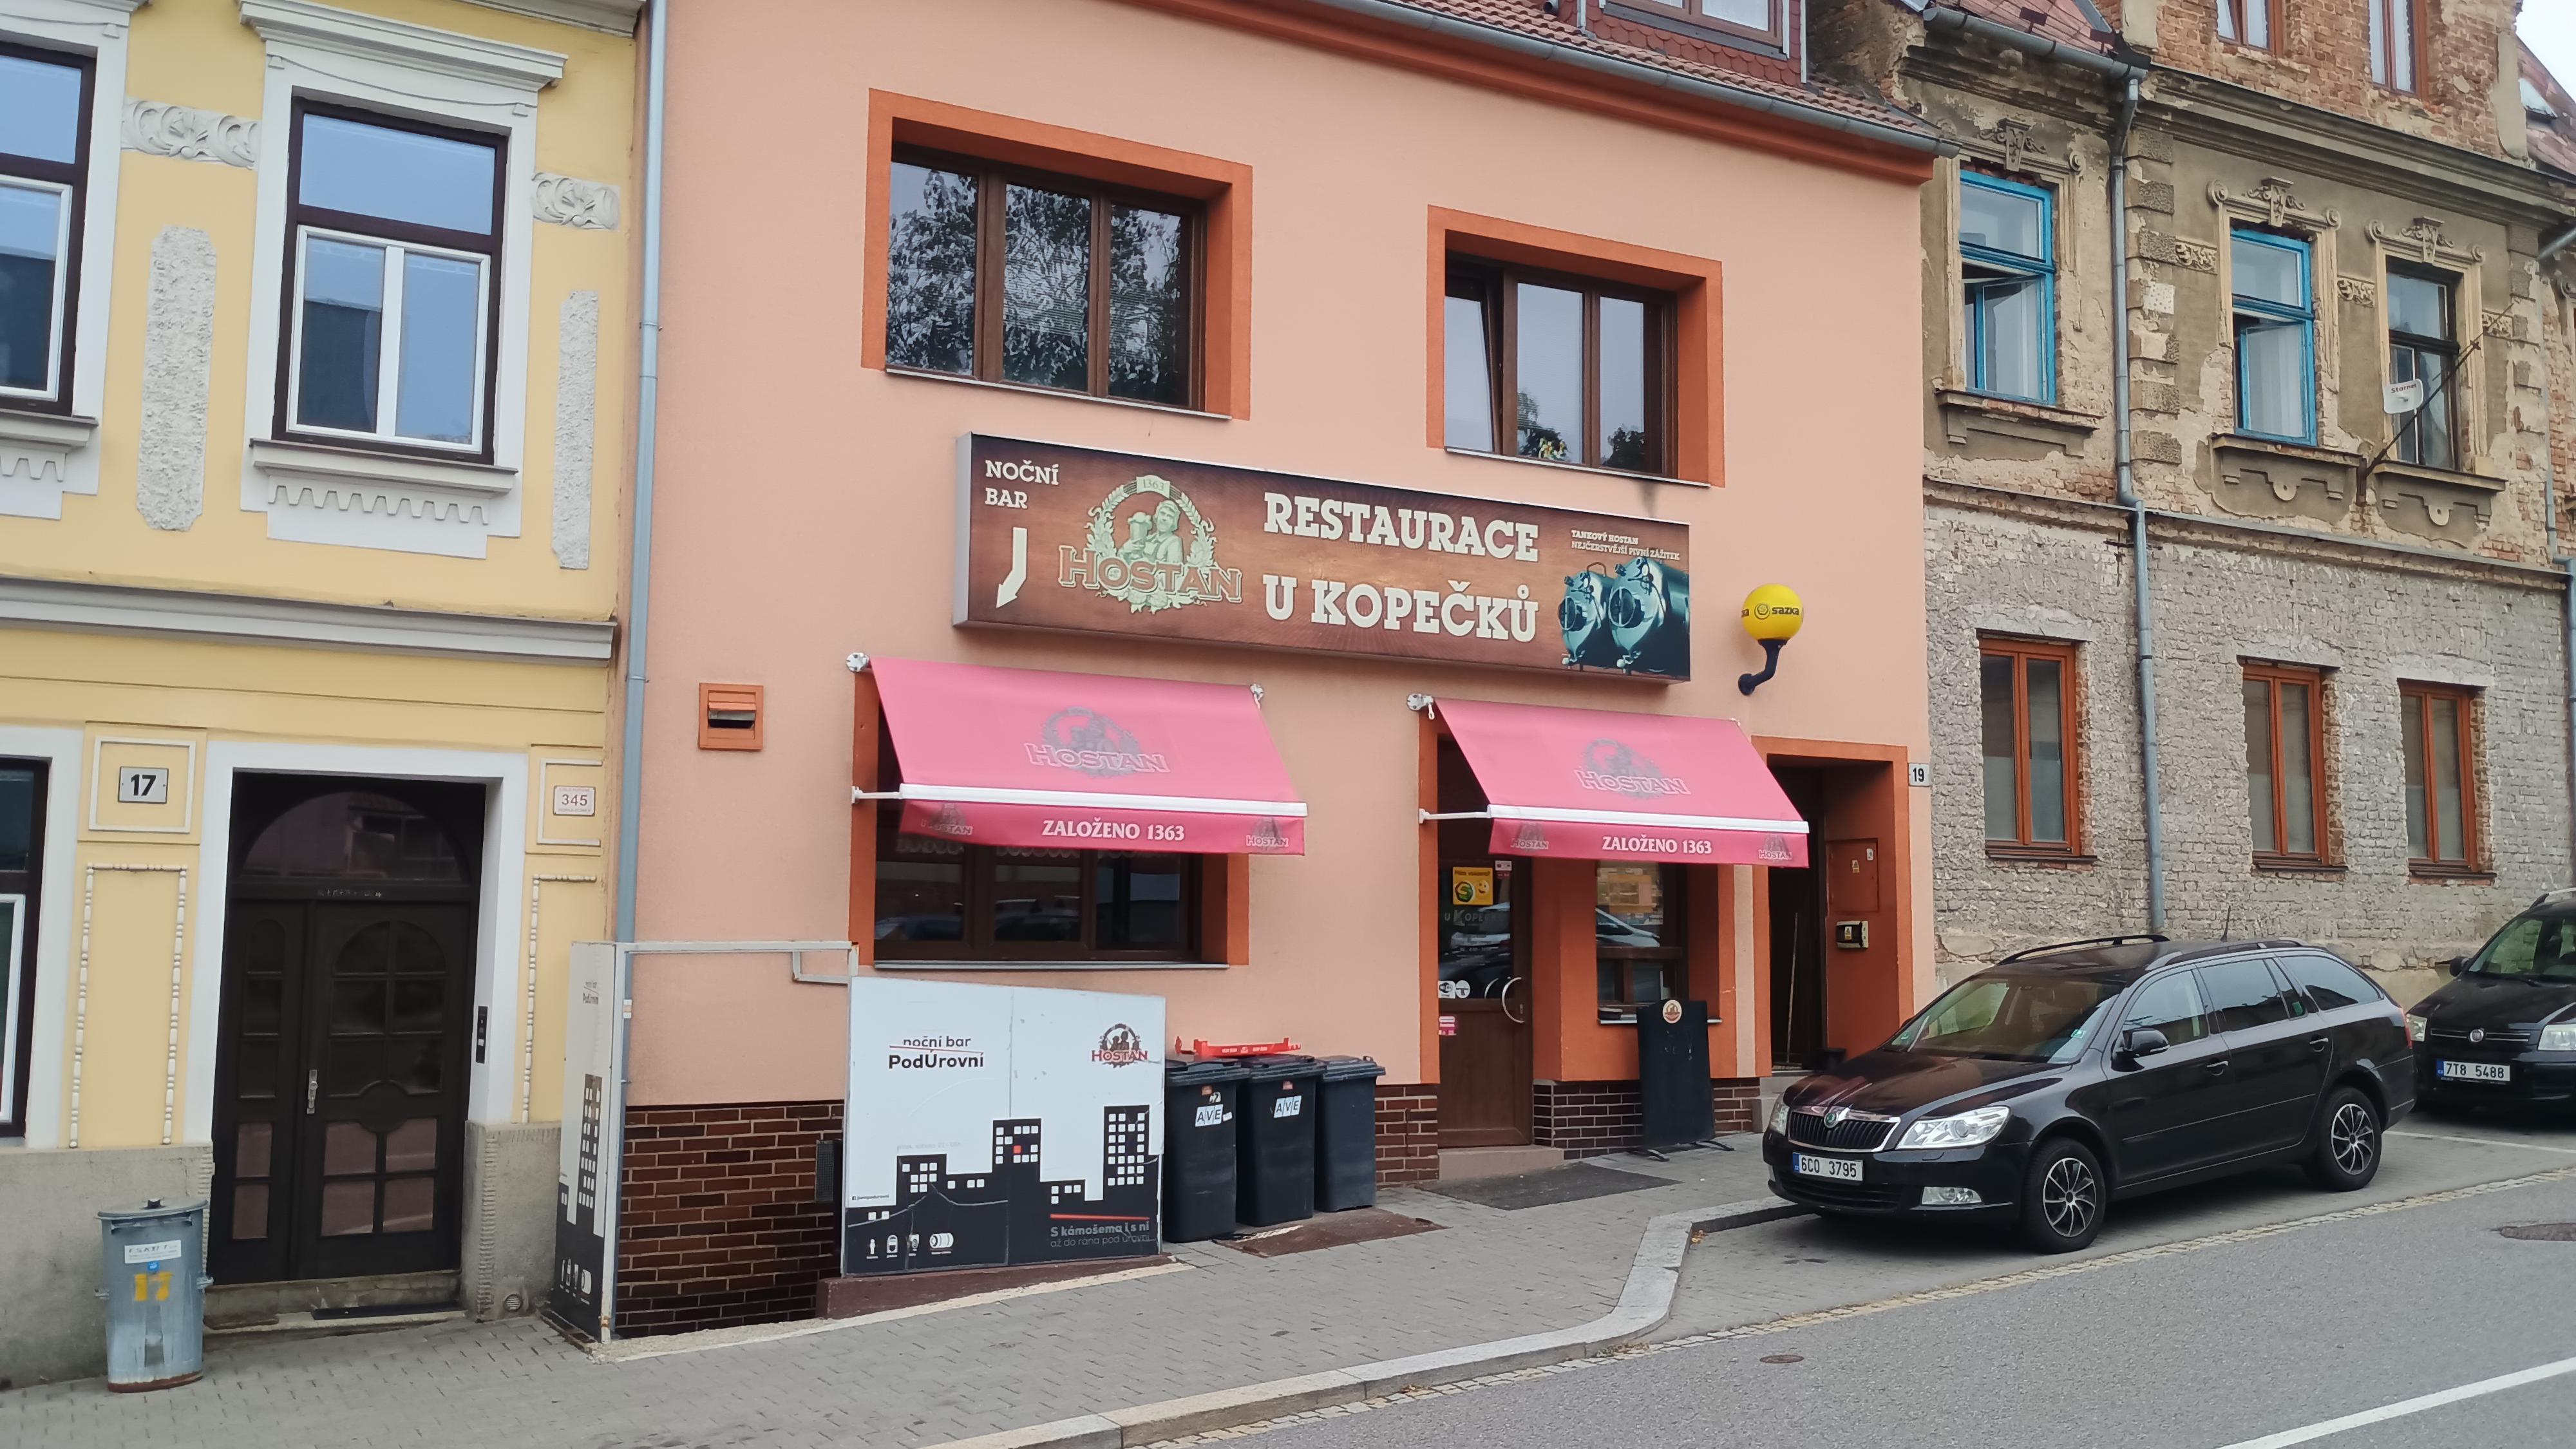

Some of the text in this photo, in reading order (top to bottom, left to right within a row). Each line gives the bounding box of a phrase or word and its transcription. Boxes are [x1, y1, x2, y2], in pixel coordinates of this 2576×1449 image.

[2391, 383, 2416, 393] Starnet
[985, 460, 1059, 486] NOČNÍ
[1143, 478, 1165, 491] 1363
[985, 488, 1028, 509] BAR
[1264, 492, 1538, 562] RESTAURACE
[1571, 529, 1639, 545] TANKOVÝ HOSTAN
[1629, 547, 1649, 558] PIVNÍ
[1650, 549, 1680, 561] ZÁŽITEK
[1058, 545, 1242, 603] HOSTAN
[1263, 574, 1539, 642] U KOPEČKŮ
[1024, 743, 1170, 773] HOSTAN
[1574, 770, 1691, 795] HOSTAN
[1913, 767, 1924, 782] 19
[131, 774, 156, 796] 17
[562, 794, 587, 806] 345
[1042, 817, 1184, 840] ZALOŽENO 1363
[1245, 835, 1289, 848] HOSTAN
[1602, 834, 1712, 854] ZALOŽENO 1363
[903, 1036, 971, 1048] noční bar
[1092, 1050, 1148, 1061] HOSTAN
[2447, 1063, 2466, 1075] 7T8
[2476, 1065, 2504, 1079] 5488
[1276, 1099, 1299, 1112] AVE
[1197, 1109, 1222, 1124] AVE
[1801, 1157, 1820, 1173] 6C0
[1829, 1160, 1857, 1178] 3795
[1050, 1226, 1058, 1237] S
[1064, 1238, 1076, 1247] do
[1102, 1235, 1120, 1246] pod
